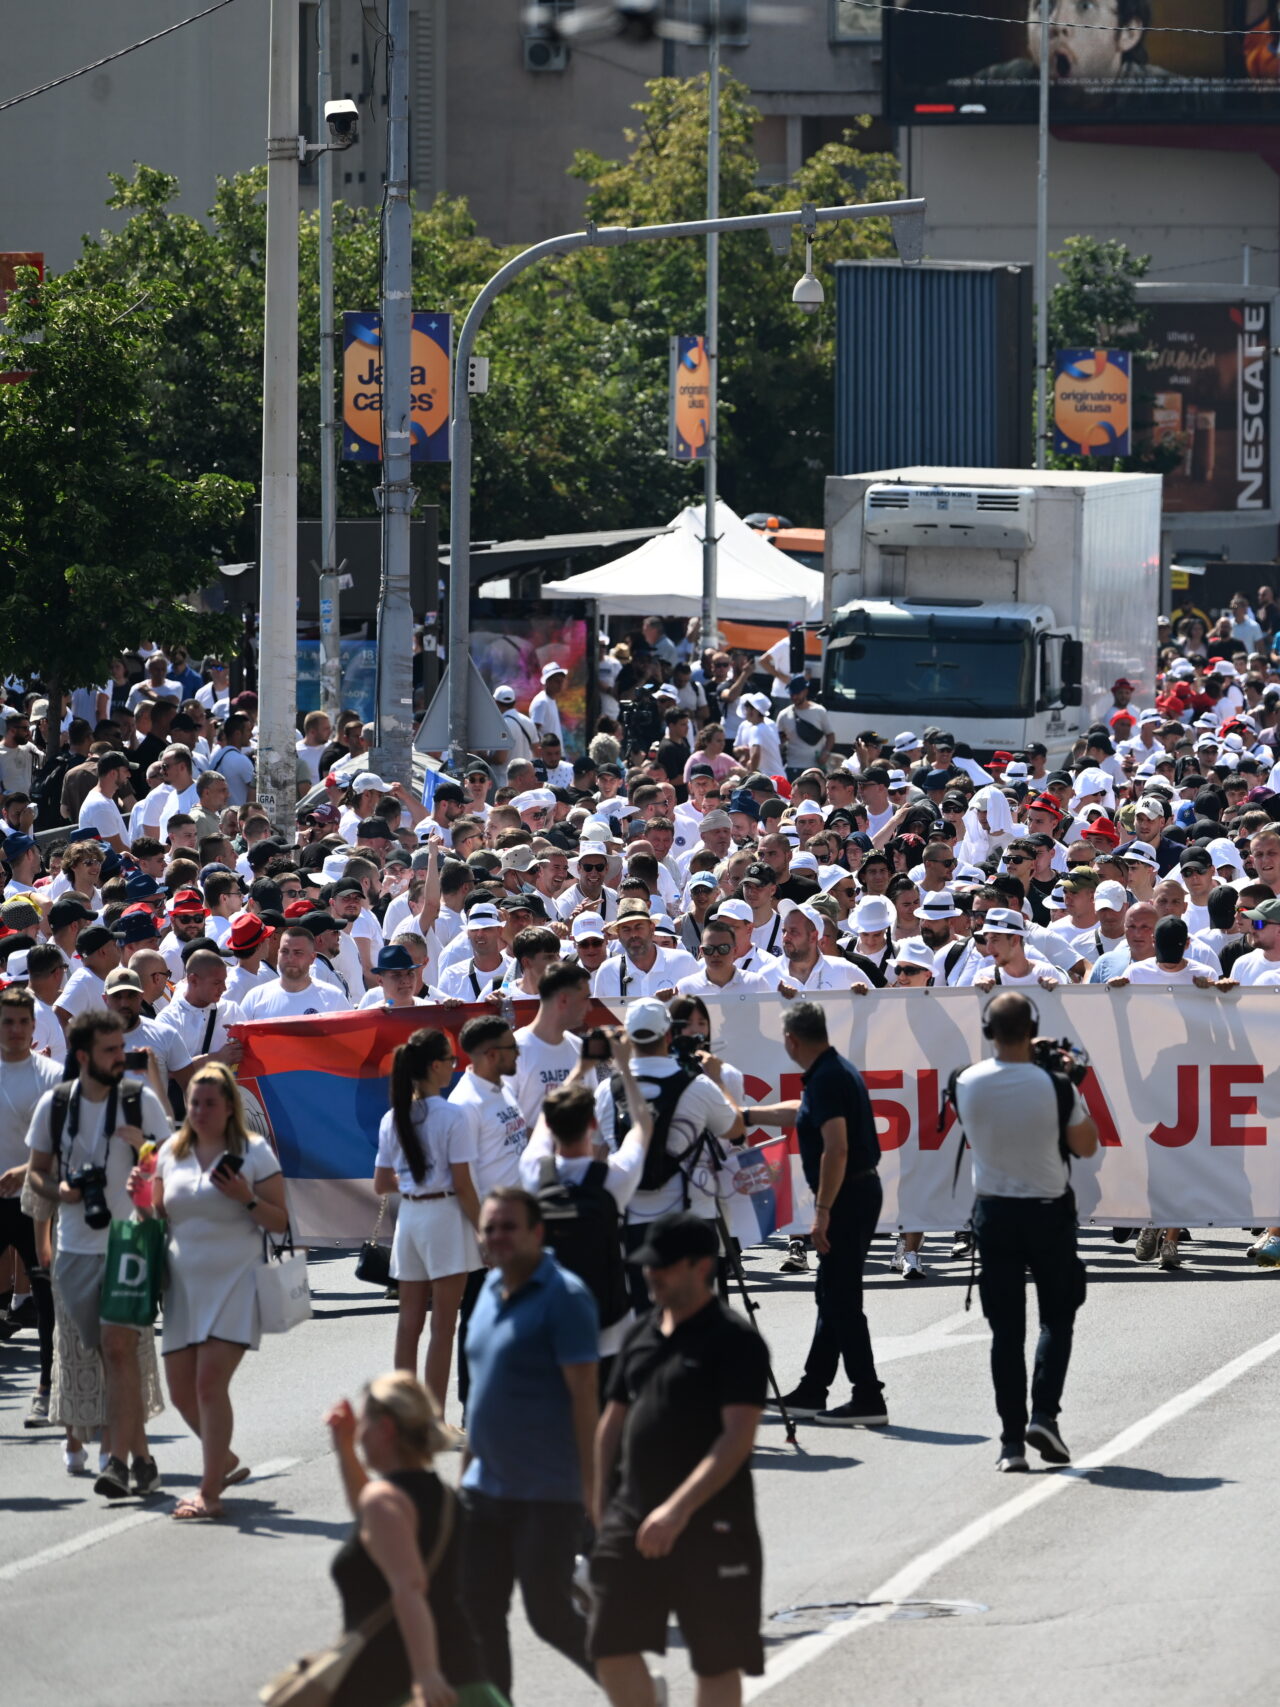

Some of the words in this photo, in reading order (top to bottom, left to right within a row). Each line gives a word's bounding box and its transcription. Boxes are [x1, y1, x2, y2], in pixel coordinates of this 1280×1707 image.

[1060, 389, 1127, 404] originalnog
[1075, 402, 1112, 413] ukusa
[118, 1253, 147, 1287] D
